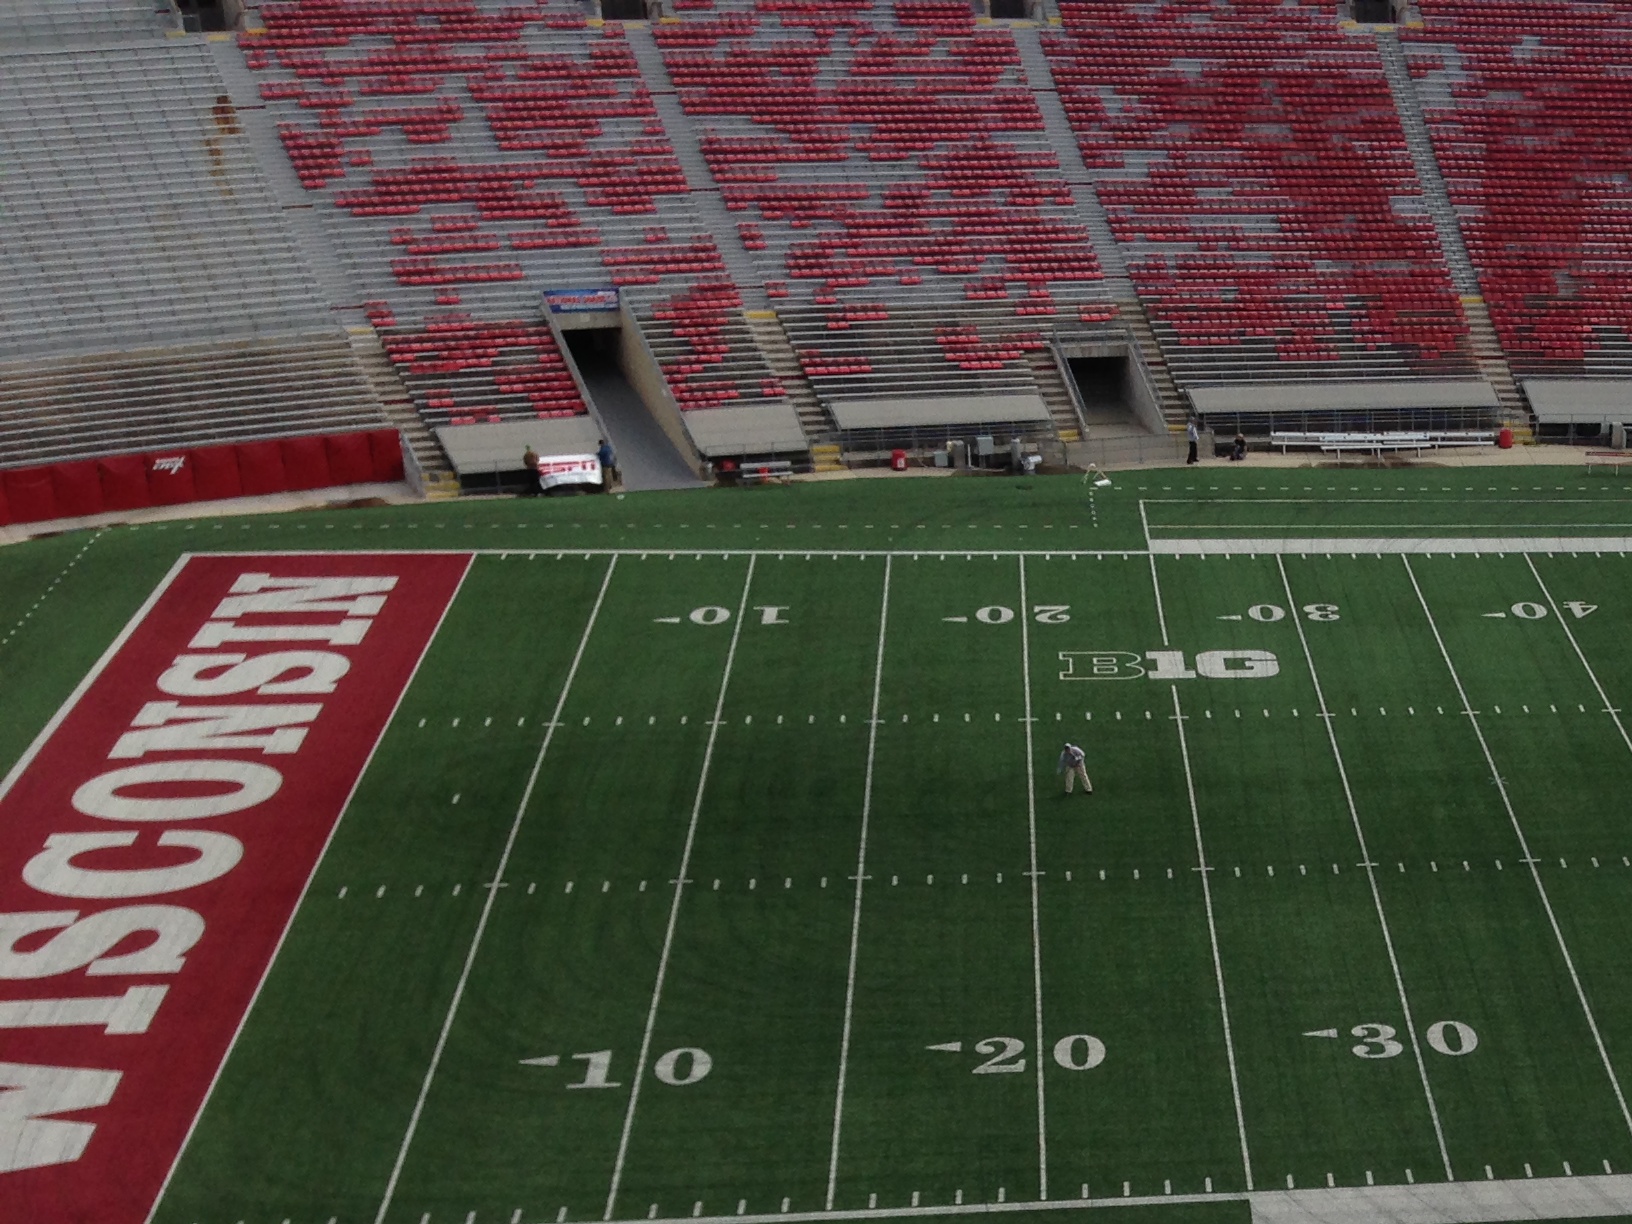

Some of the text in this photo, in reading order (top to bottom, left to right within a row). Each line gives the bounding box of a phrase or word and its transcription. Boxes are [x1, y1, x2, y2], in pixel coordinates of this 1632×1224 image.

[538, 460, 596, 477] ESPN
[689, 606, 790, 625] 10
[975, 605, 1071, 624] 20
[1248, 604, 1340, 622] 30
[1511, 601, 1599, 619] 40
[1350, 1020, 1479, 1059] 30
[971, 1034, 1106, 1075] 20
[565, 1047, 714, 1089] 10
